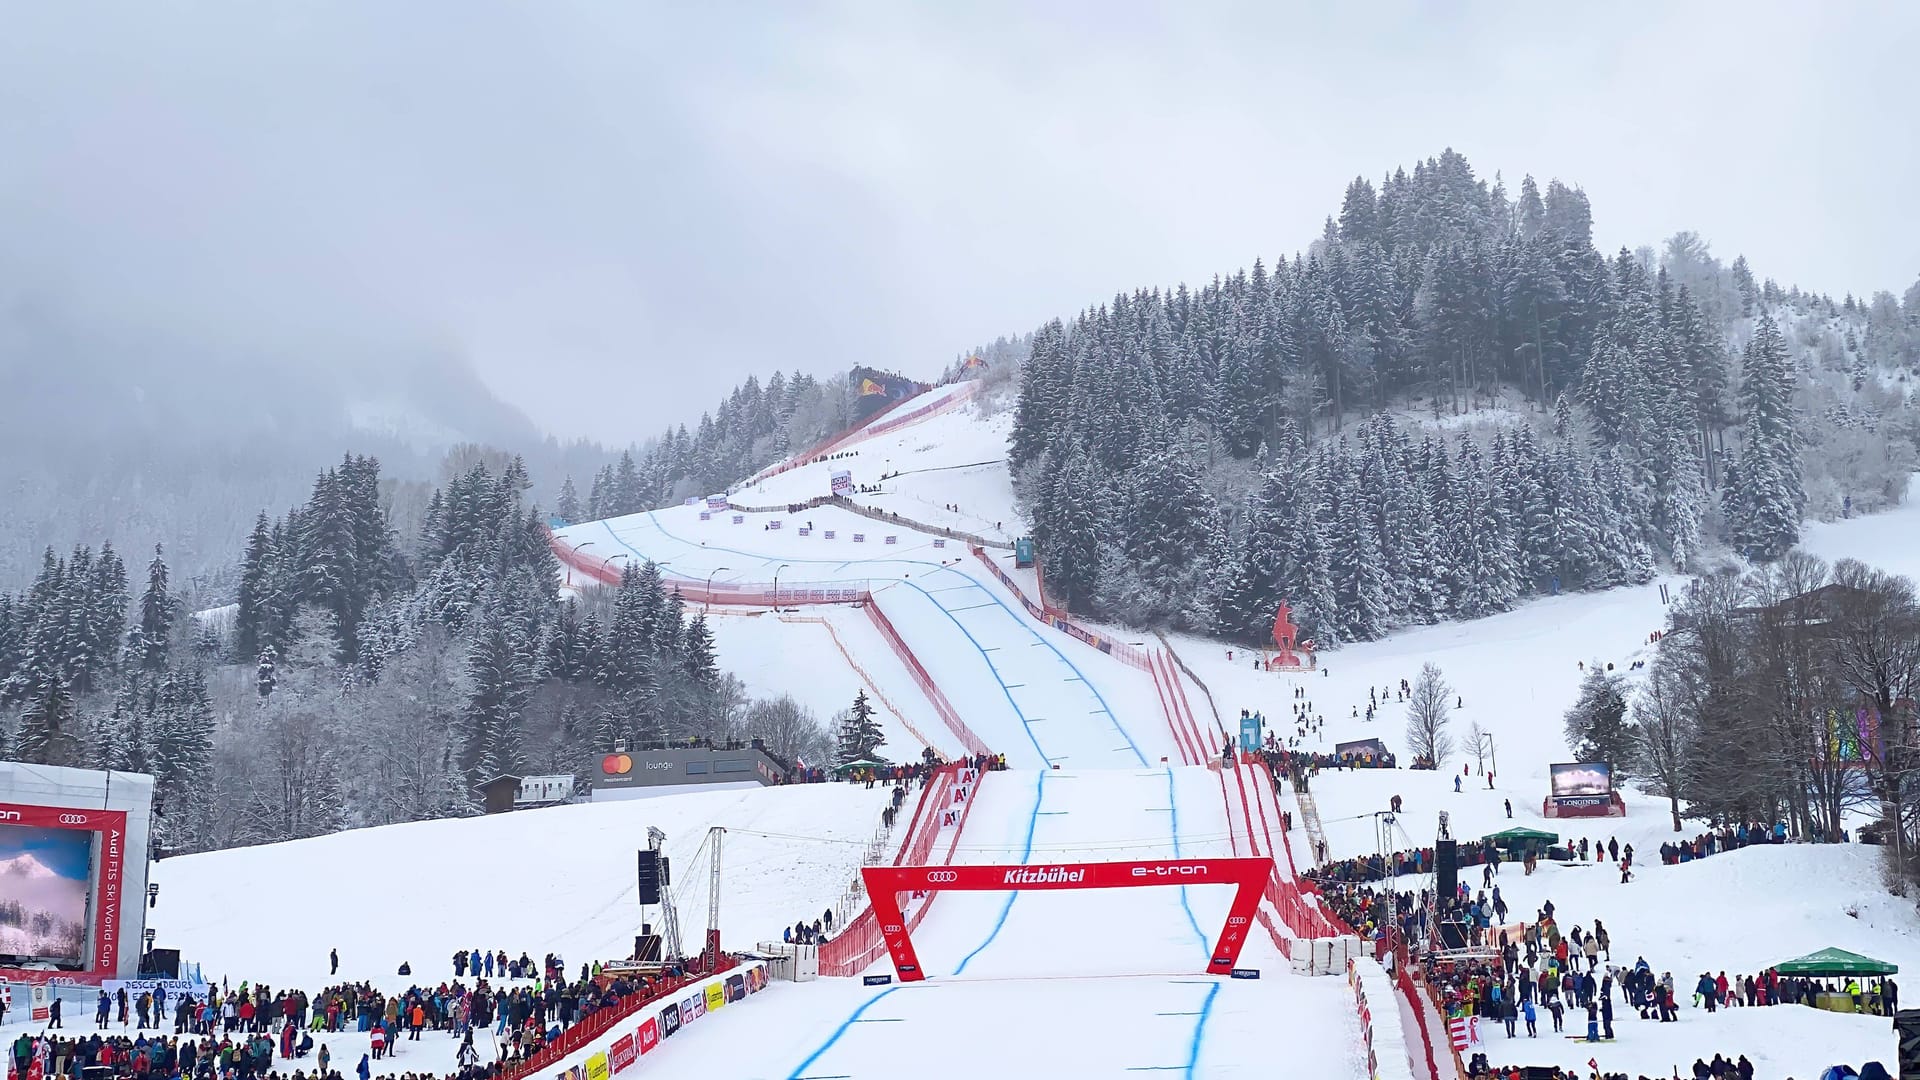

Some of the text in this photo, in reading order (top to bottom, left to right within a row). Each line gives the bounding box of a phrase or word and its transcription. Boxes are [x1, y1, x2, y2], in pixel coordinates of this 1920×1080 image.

[646, 761, 673, 770] lounge
[962, 769, 975, 784] A1
[954, 786, 967, 803] A1
[943, 811, 956, 826] A1
[1003, 867, 1085, 884] Kitzbühel
[1132, 866, 1207, 877] e-tron
[101, 829, 120, 967] Audi FIS Ski World Cup
[126, 981, 193, 990] DESCEDEURS
[665, 1011, 679, 1030] BOSS
[643, 1025, 655, 1047] Audi
